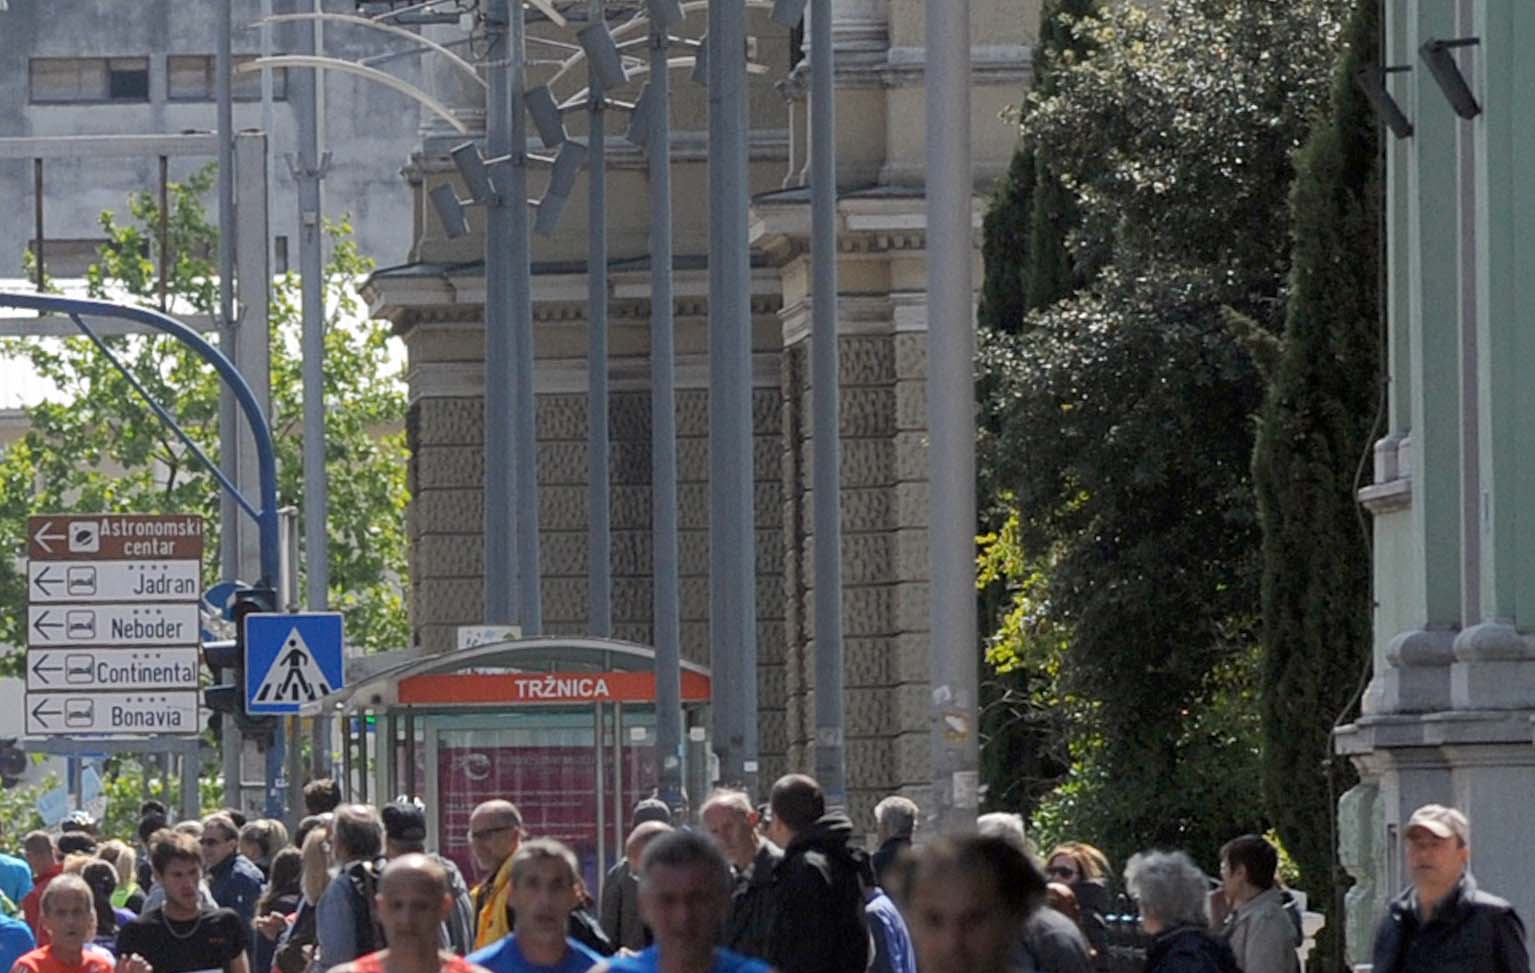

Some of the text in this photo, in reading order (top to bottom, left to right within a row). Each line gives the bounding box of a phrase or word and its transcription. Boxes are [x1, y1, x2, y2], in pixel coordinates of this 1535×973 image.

[100, 518, 201, 537] Astronomski
[124, 539, 175, 555] centar
[133, 573, 196, 595] Jadran
[112, 618, 183, 639] Neboder
[97, 662, 196, 683] Continental
[515, 675, 609, 698] TRŽNICA
[112, 706, 181, 727] Bonavia
